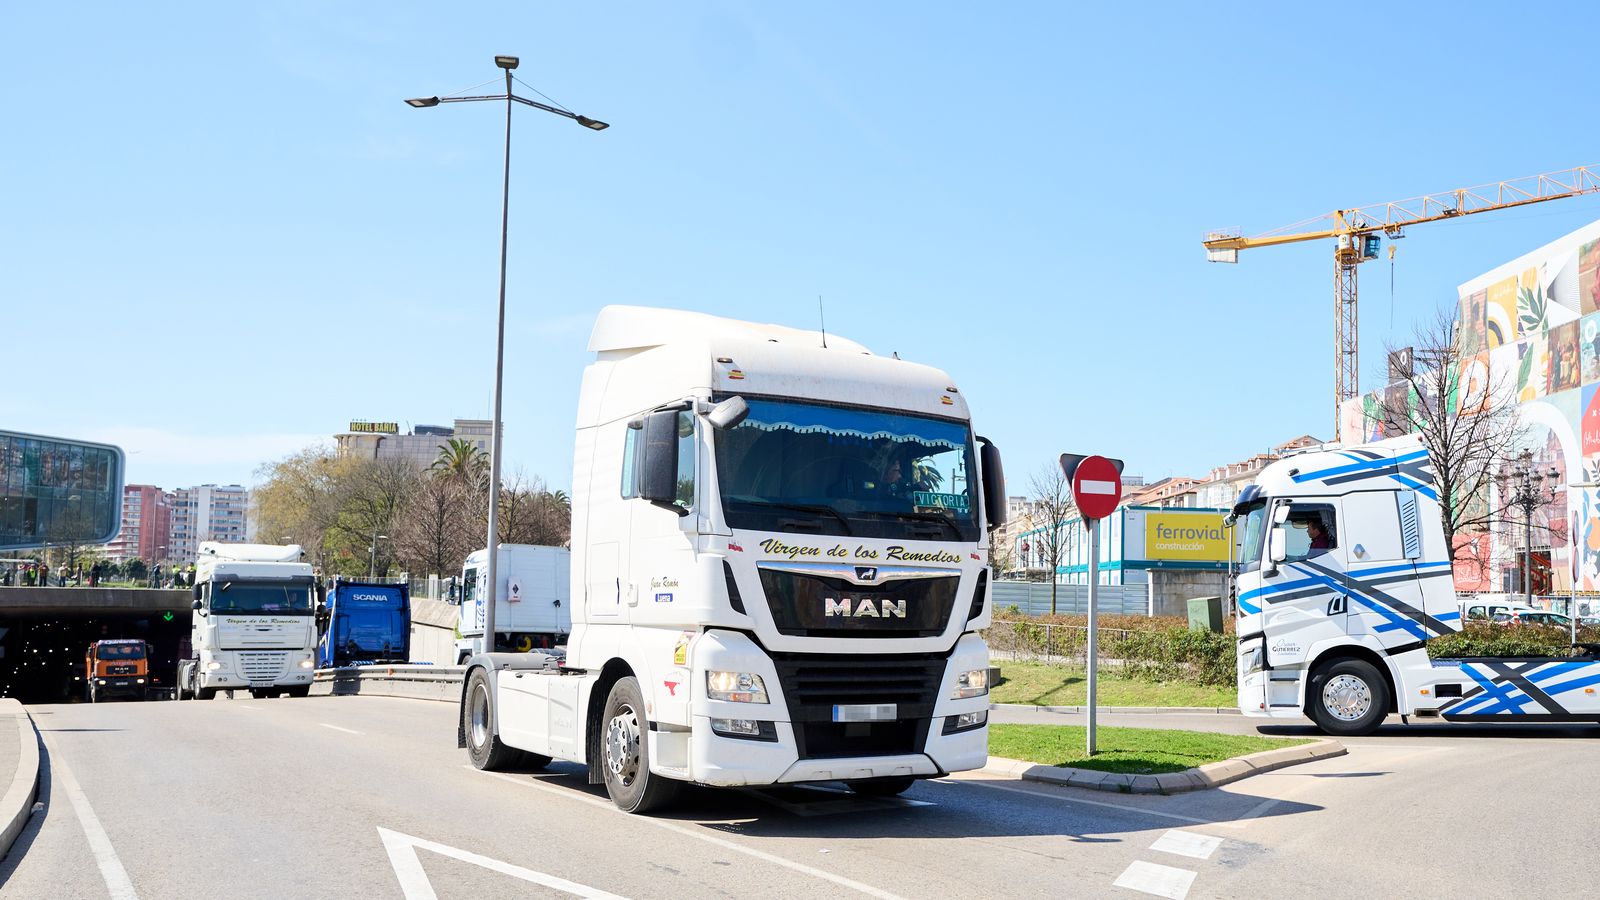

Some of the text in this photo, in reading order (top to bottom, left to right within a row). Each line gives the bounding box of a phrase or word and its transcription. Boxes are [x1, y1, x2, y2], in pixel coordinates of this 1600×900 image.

[351, 422, 373, 431] HOTEL
[918, 494, 966, 507] VICTORIA
[1156, 523, 1226, 540] ferrovial
[759, 538, 962, 564] Virgen de los Remedios
[1155, 541, 1205, 551] construcción
[352, 593, 388, 602] SCANIA
[824, 598, 907, 618] MAN
